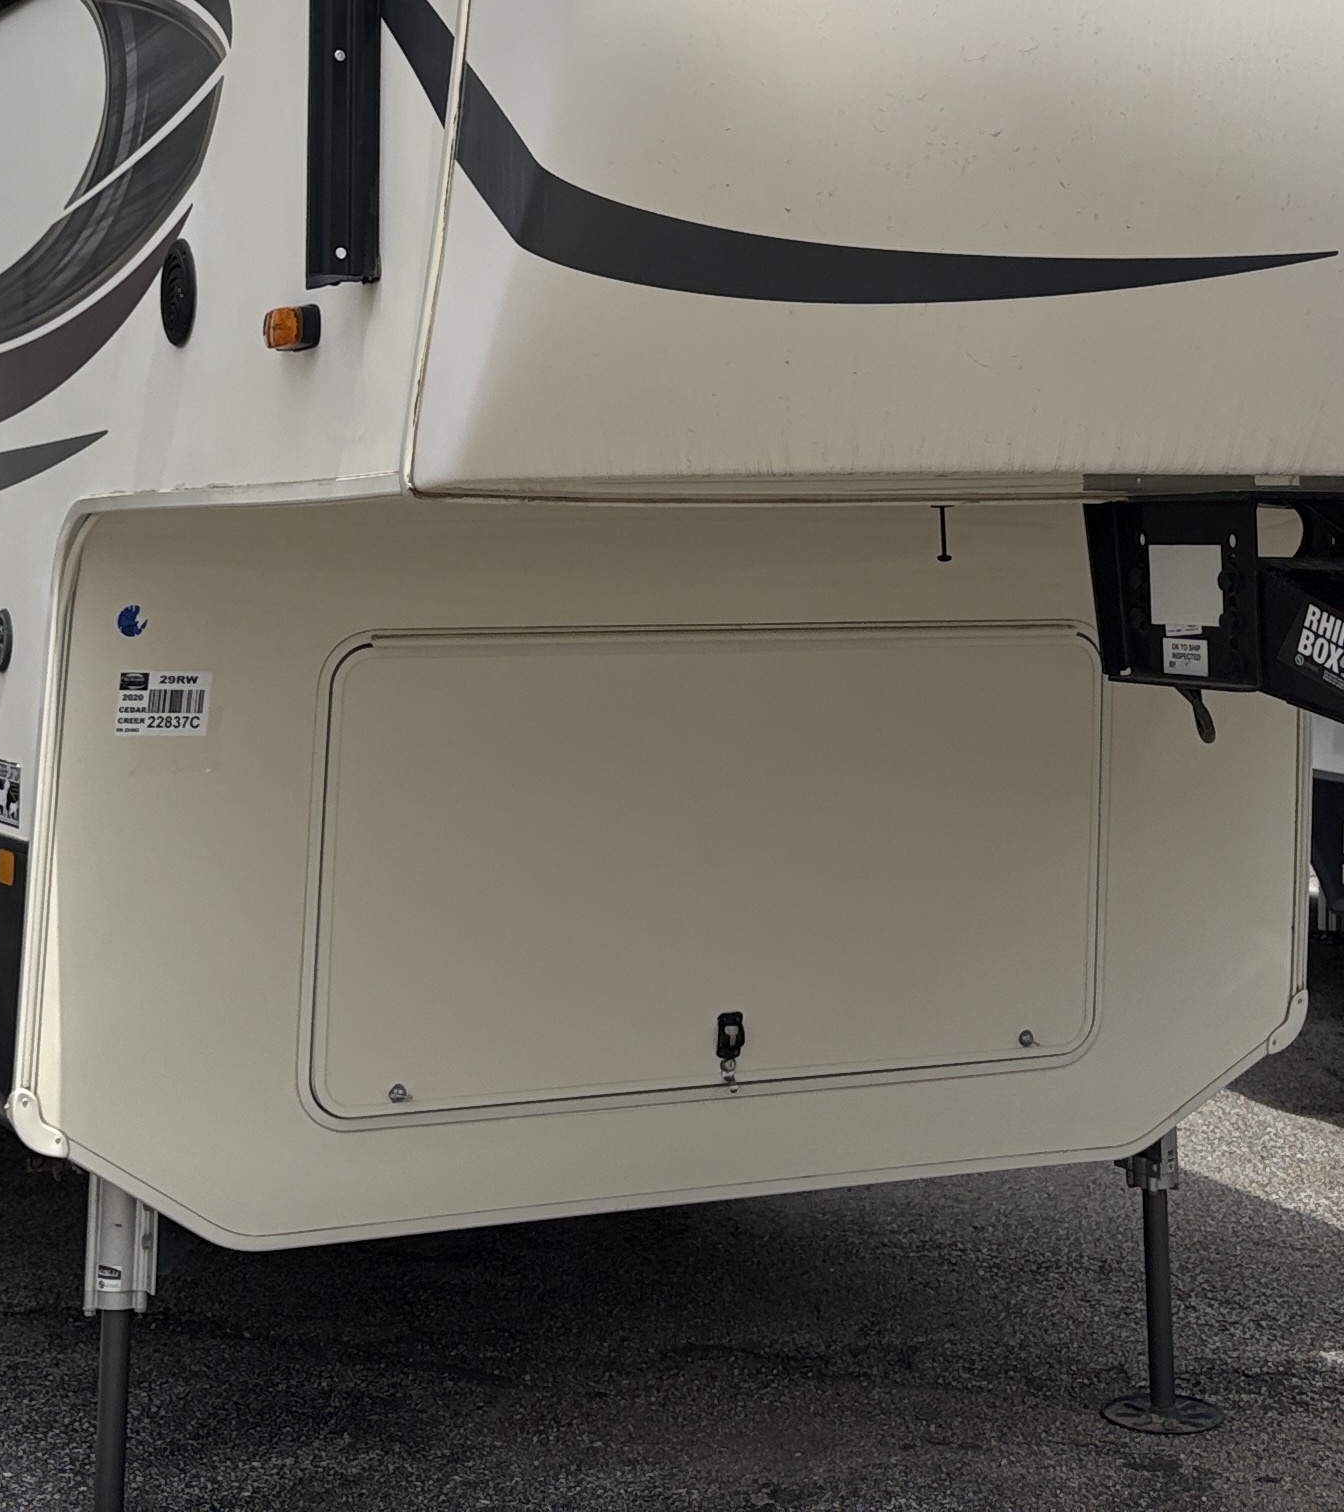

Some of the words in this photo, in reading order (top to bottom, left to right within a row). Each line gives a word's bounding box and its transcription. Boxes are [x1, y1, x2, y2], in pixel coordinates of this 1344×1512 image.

[1297, 627, 1344, 675] BOX
[159, 675, 199, 685] 29RW
[146, 715, 201, 729] 22837C
